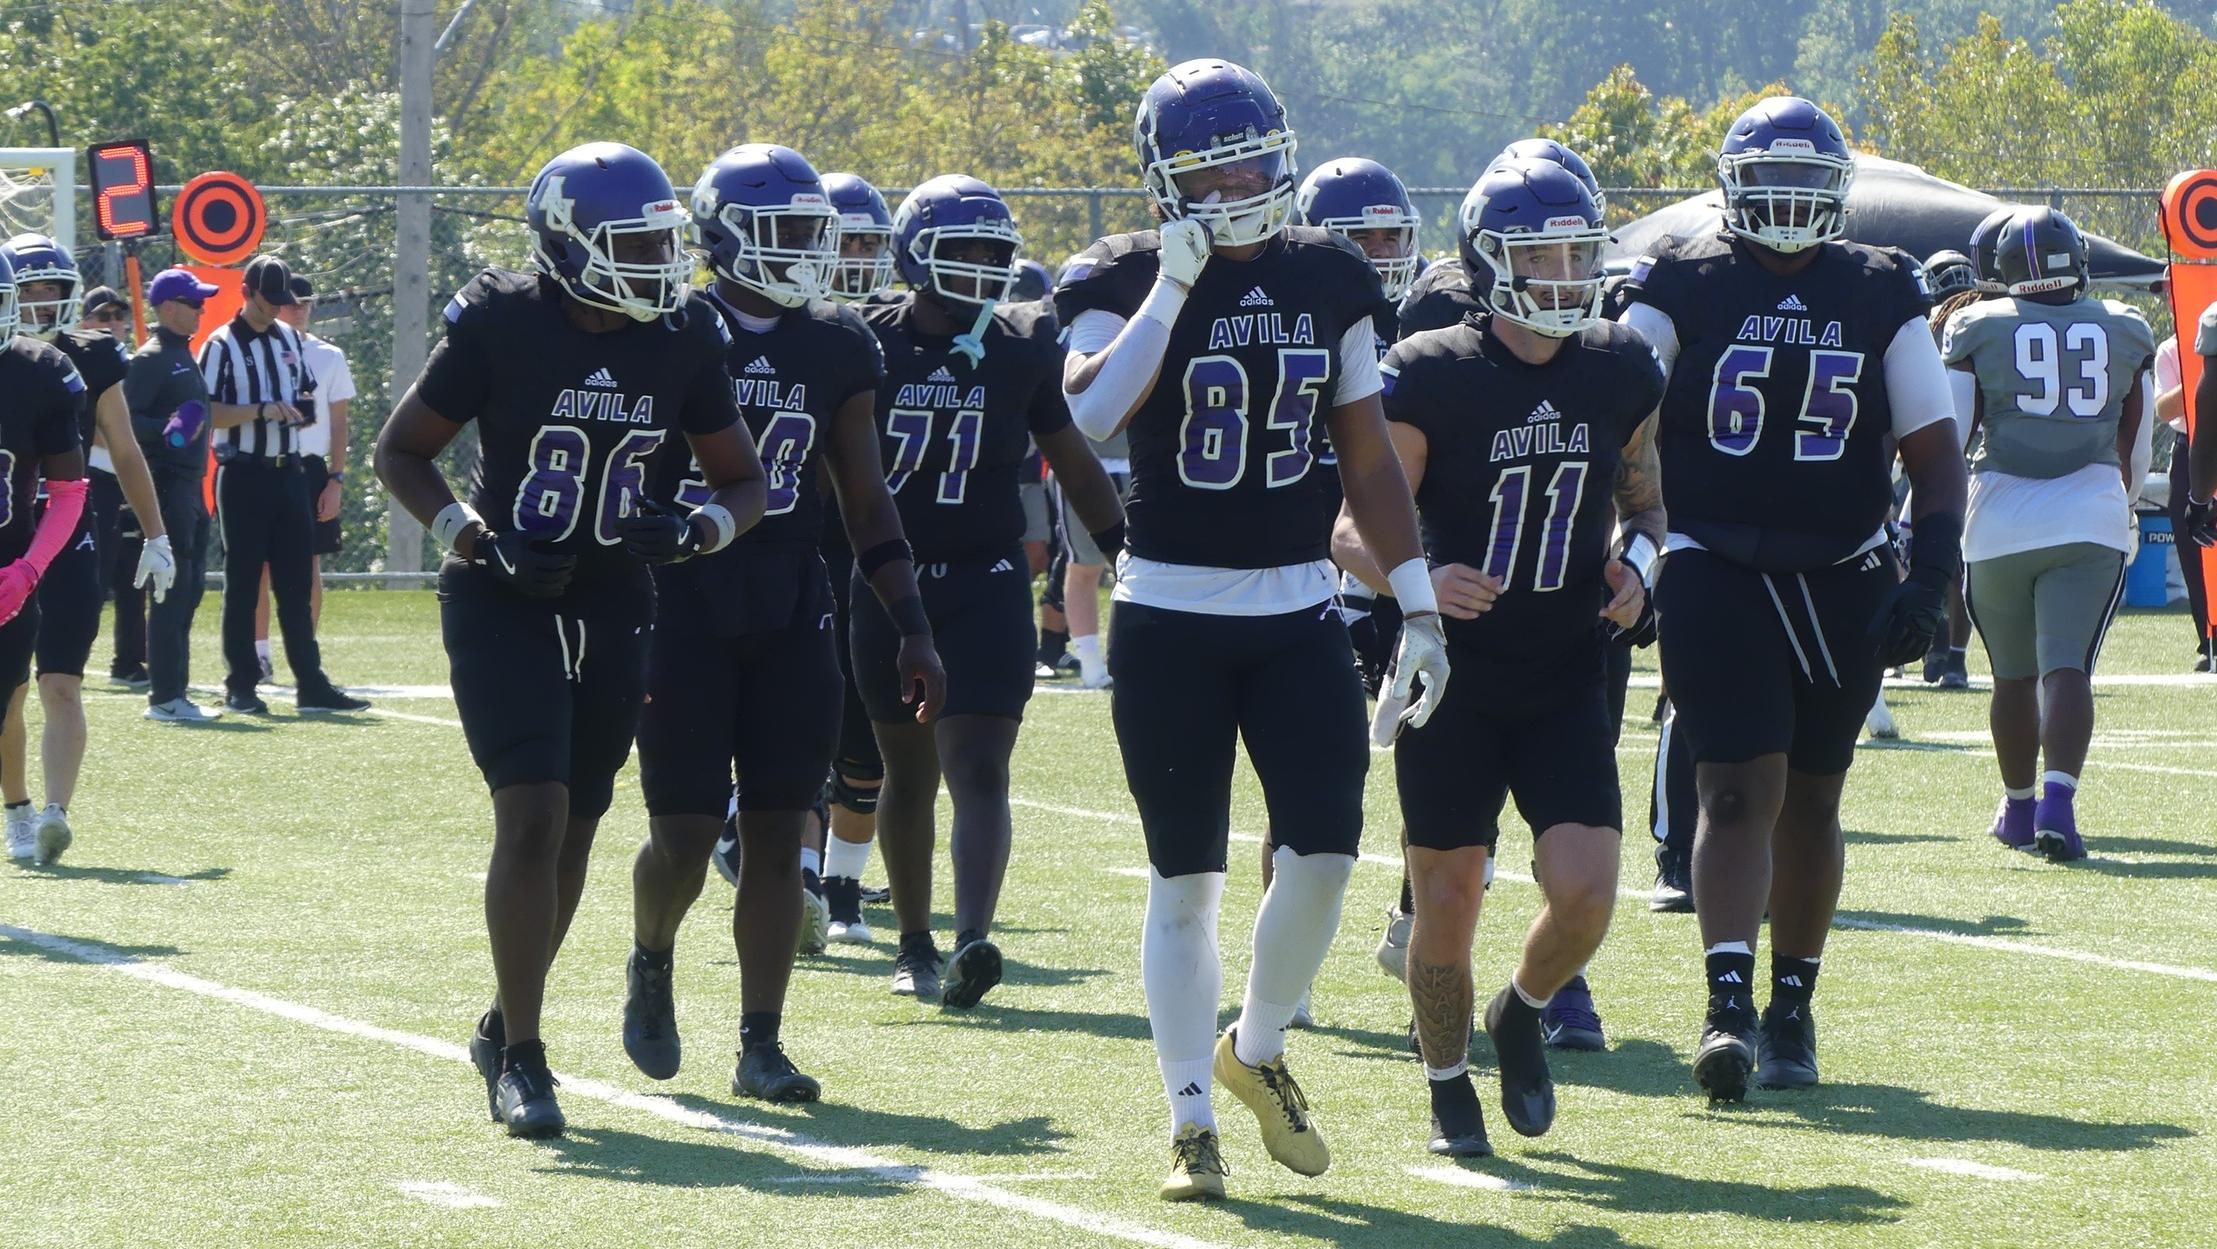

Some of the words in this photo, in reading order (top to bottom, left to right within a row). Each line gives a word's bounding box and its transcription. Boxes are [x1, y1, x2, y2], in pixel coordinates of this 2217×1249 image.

[98, 146, 148, 234] 2
[1550, 218, 1584, 227] Riddell
[1239, 297, 1274, 307] adidas
[2018, 280, 2063, 294] Riddell
[1777, 303, 1807, 311] adidas
[1208, 313, 1315, 351] AVILA
[1736, 315, 1843, 348] AVILA
[584, 377, 618, 388] adidas
[744, 365, 776, 374] adidas
[2014, 322, 2110, 418] 93
[550, 388, 653, 424] AVILA
[735, 378, 806, 411] VILA
[894, 384, 985, 410] AVILA
[1707, 344, 1865, 462] 65
[1177, 348, 1329, 490] 85
[1527, 411, 1562, 423] adidas
[885, 408, 985, 504] 71
[1489, 423, 1590, 463] AVILA
[512, 425, 668, 546] 86
[1481, 461, 1590, 593] 11
